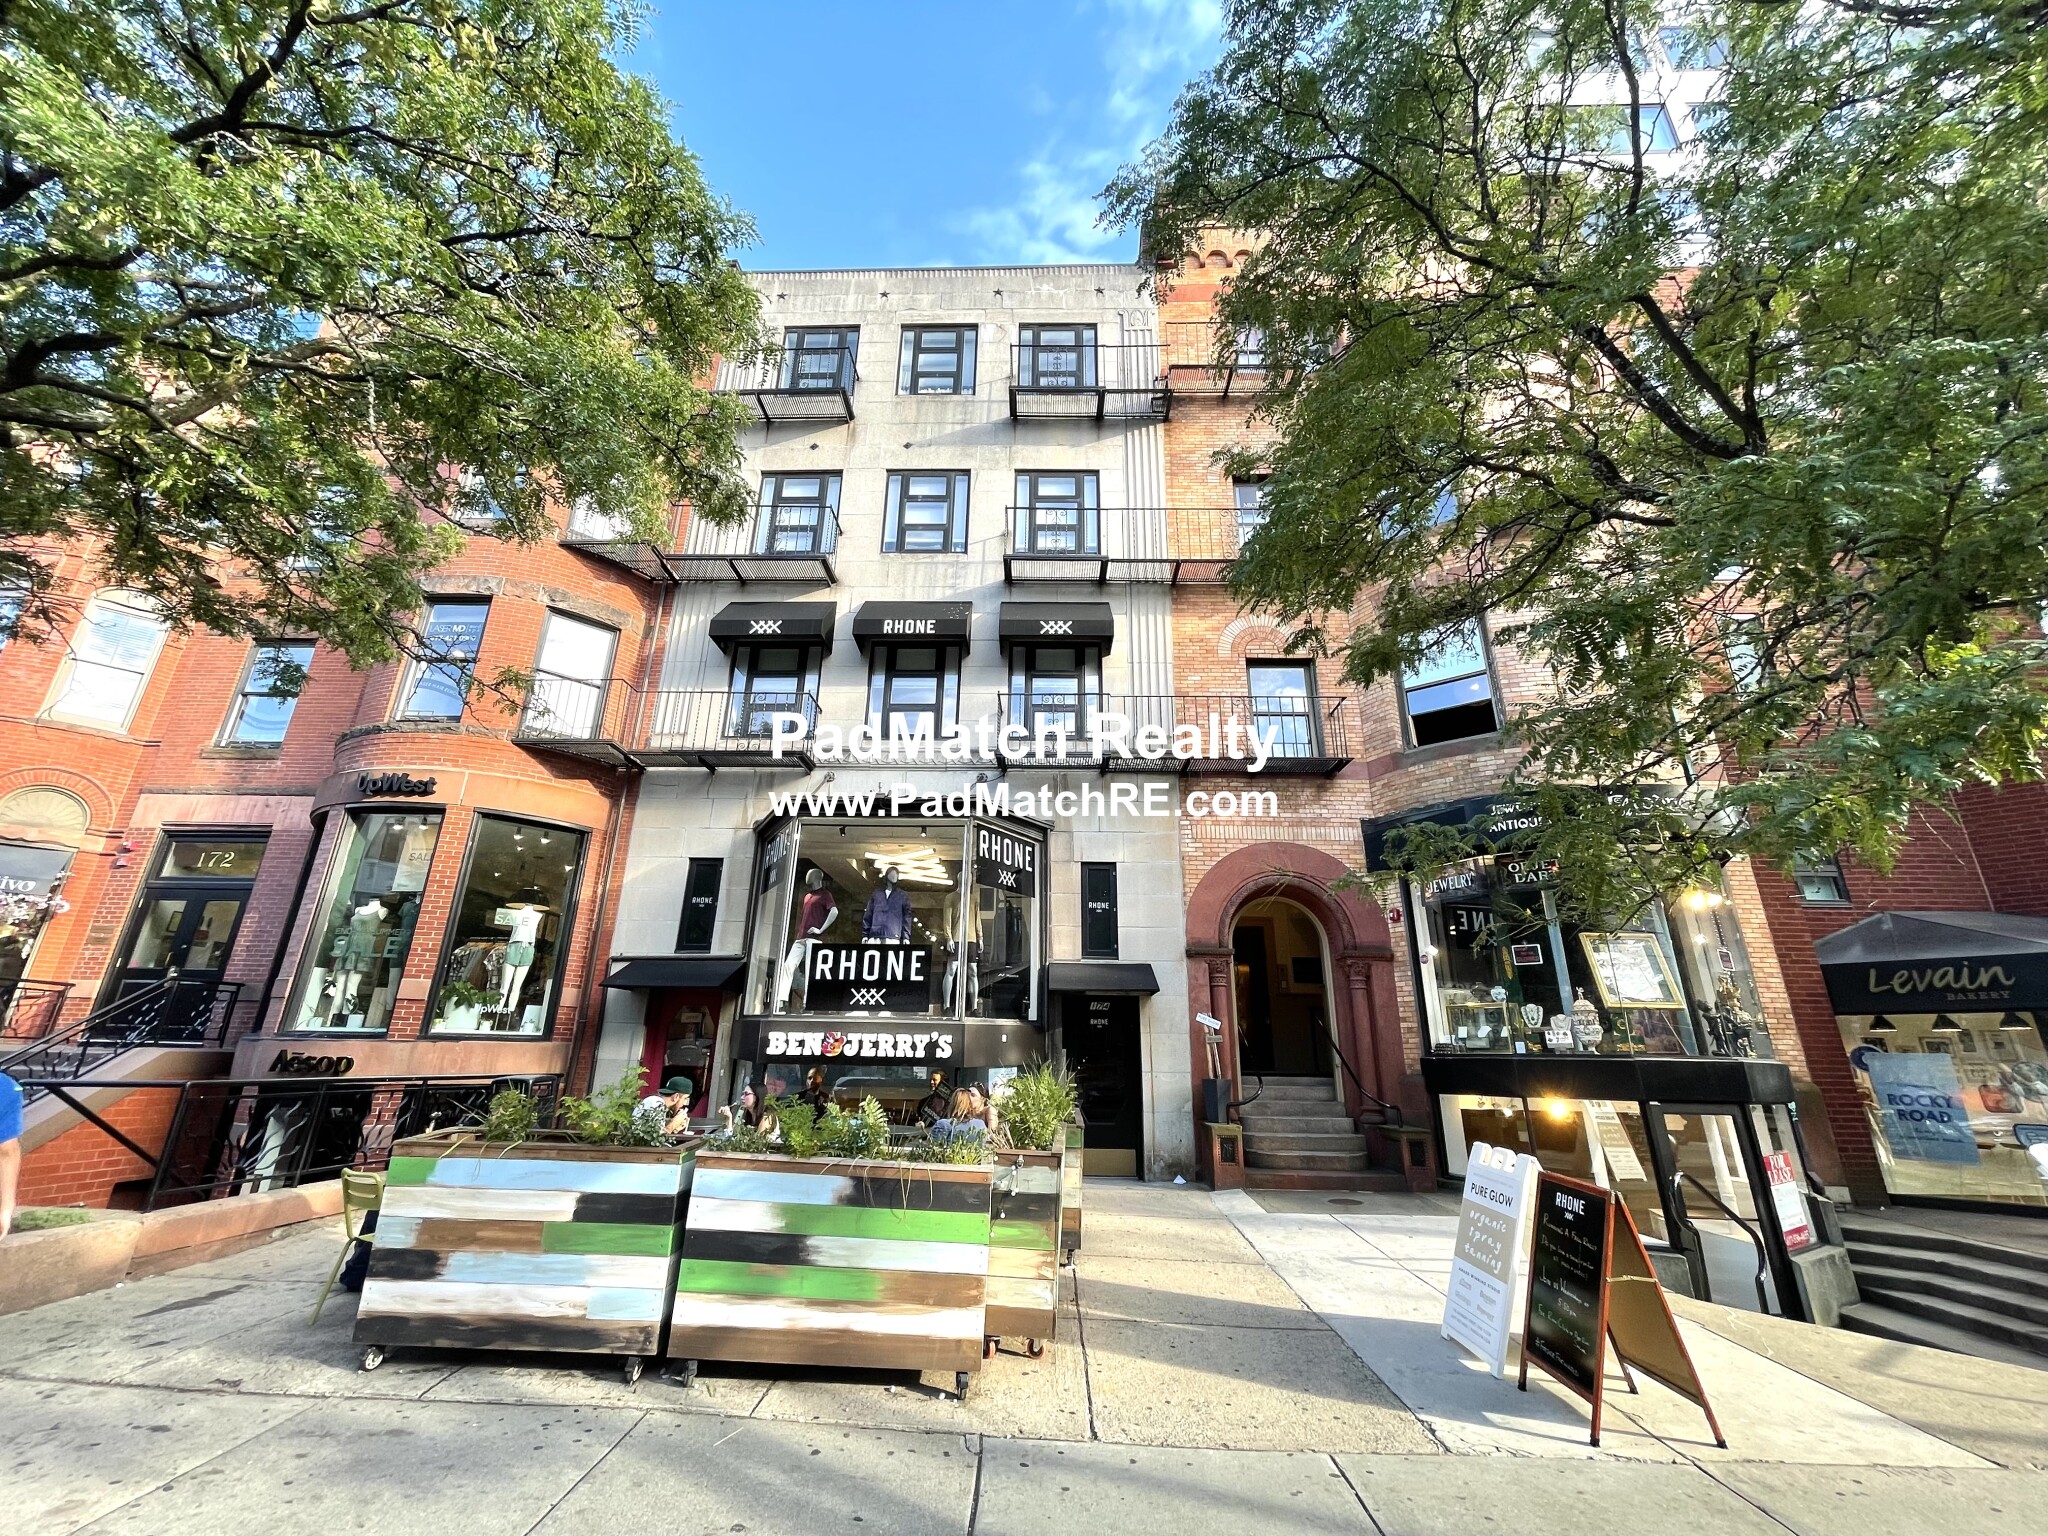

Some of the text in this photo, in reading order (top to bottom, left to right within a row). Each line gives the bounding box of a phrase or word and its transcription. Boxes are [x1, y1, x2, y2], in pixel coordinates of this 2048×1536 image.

[452, 624, 466, 633] MD
[883, 620, 936, 634] RHONE
[357, 772, 438, 796] UpWest
[197, 851, 235, 868] 172
[979, 830, 1033, 872] RHONE
[0, 875, 37, 892] ivo
[1428, 871, 1475, 894] JEWELRY
[692, 896, 714, 904] RHONE
[815, 949, 926, 981] RHONE
[1869, 961, 2016, 994] Levain
[1947, 991, 2011, 1000] BAKERY
[766, 1032, 824, 1056] BEN
[845, 1031, 953, 1058] JERRY'S
[1887, 1093, 1953, 1108] ROCKY
[1898, 1108, 1952, 1124] ROAD
[1769, 1154, 1786, 1168] FOR
[1767, 1166, 1793, 1185] LEASE
[1470, 1182, 1514, 1208] PURE GLOW
[1555, 1191, 1586, 1216] RHONE
[1469, 1209, 1507, 1233] organic
[1468, 1226, 1502, 1254] spray
[1464, 1242, 1502, 1274] tanning
